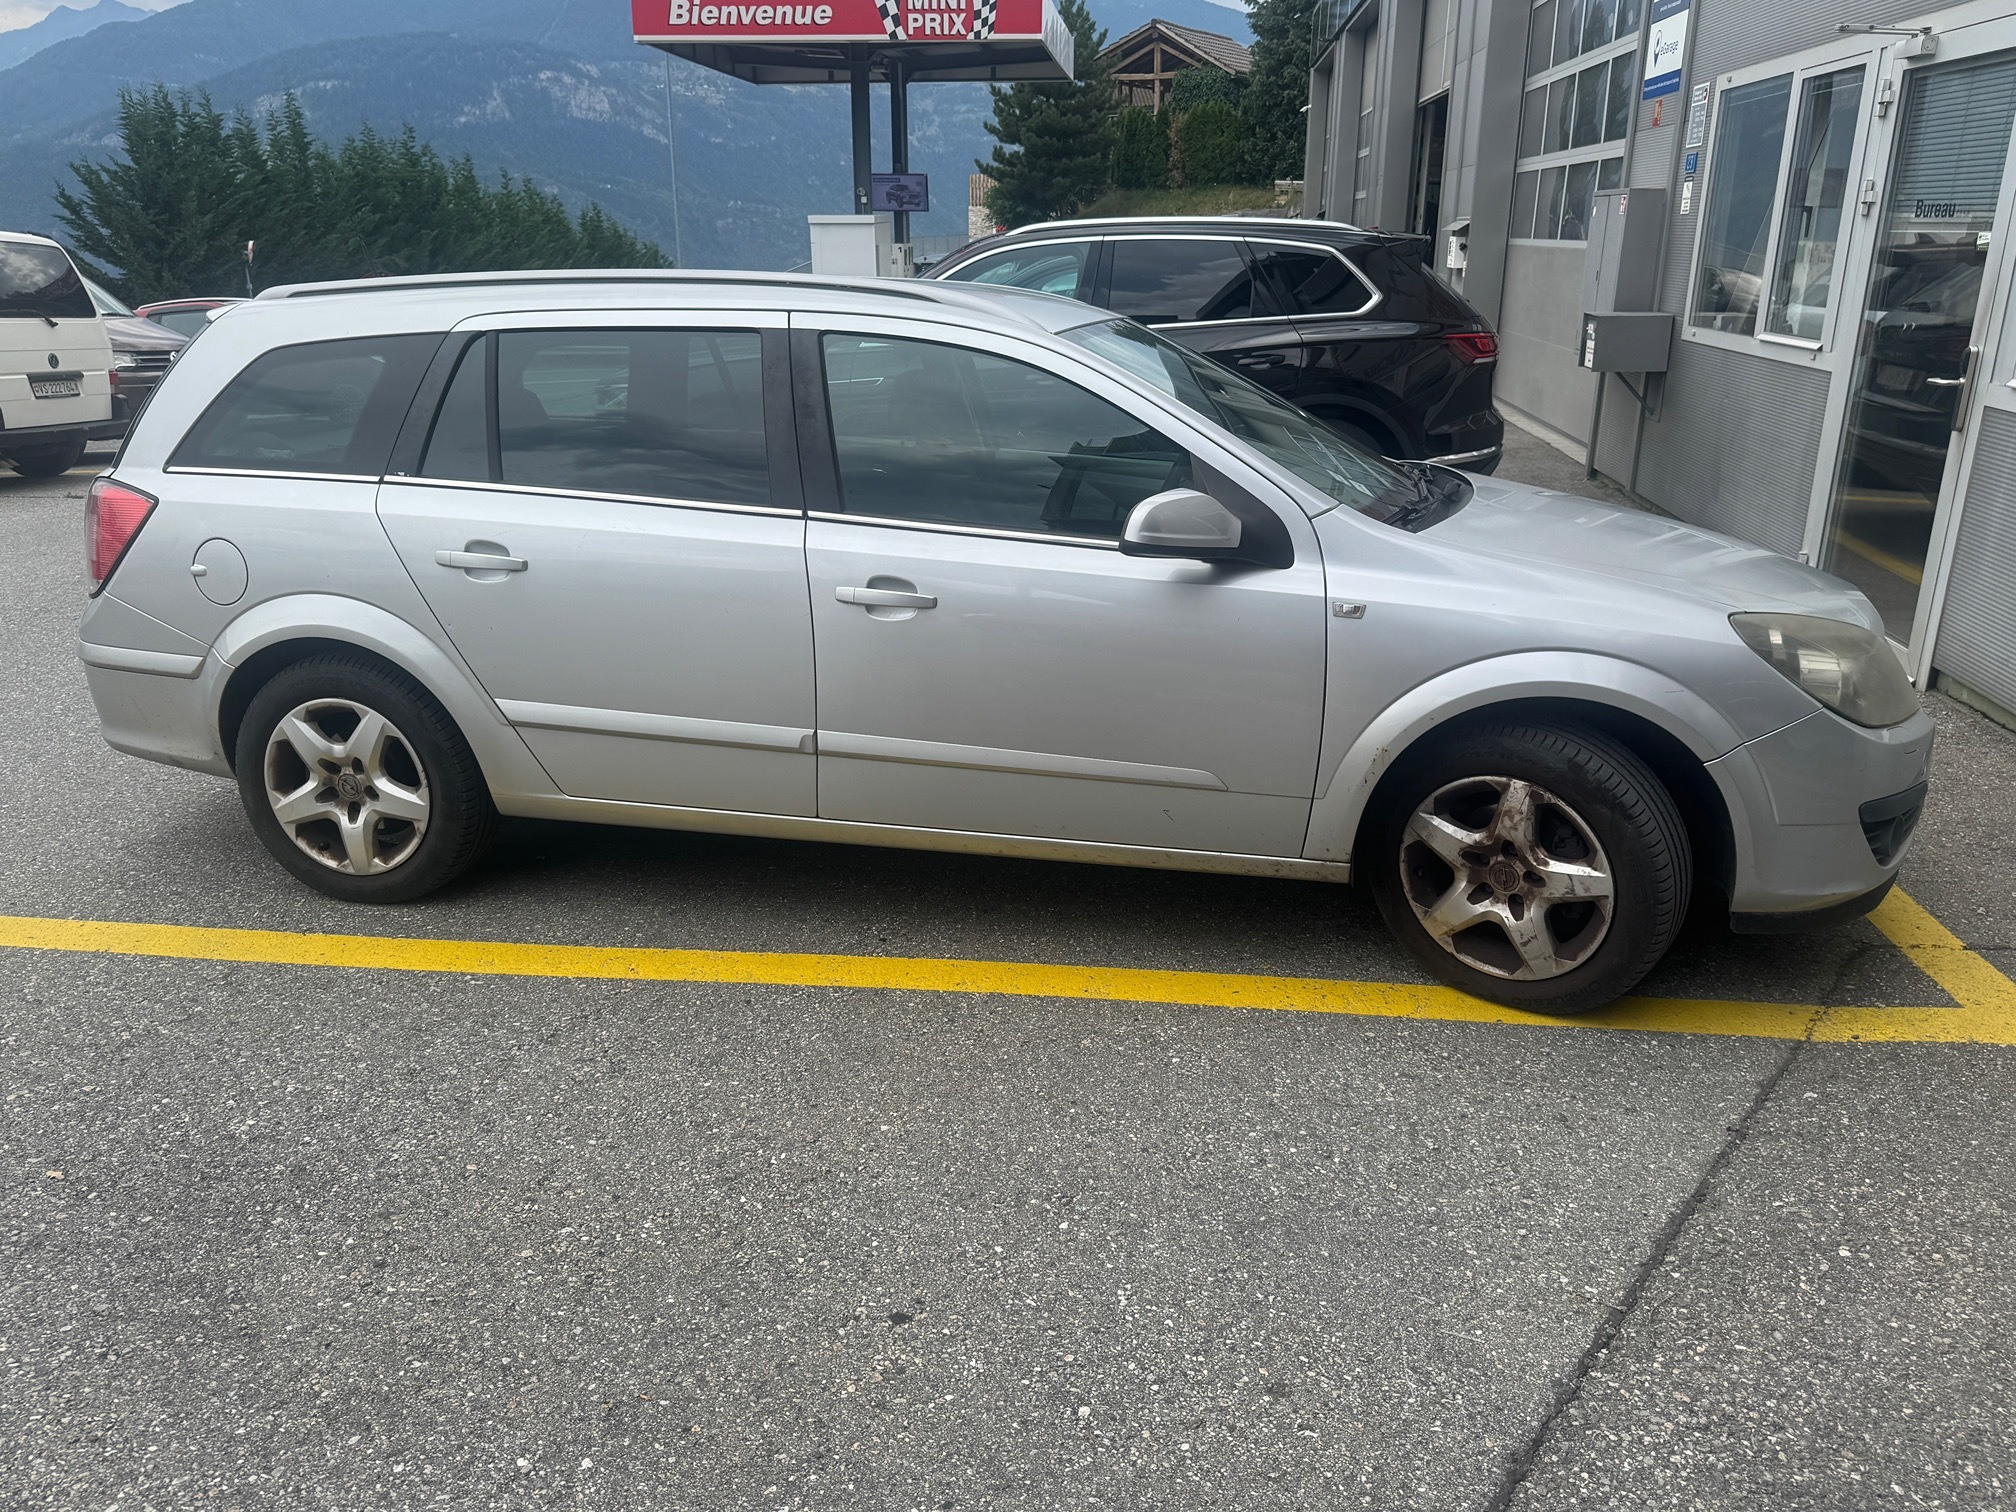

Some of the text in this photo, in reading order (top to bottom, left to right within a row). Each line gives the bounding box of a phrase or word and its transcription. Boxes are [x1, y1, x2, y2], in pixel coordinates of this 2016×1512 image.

[668, 0, 833, 26] Bienvenue
[907, 13, 967, 36] PRIX
[1914, 199, 1956, 218] Bureau
